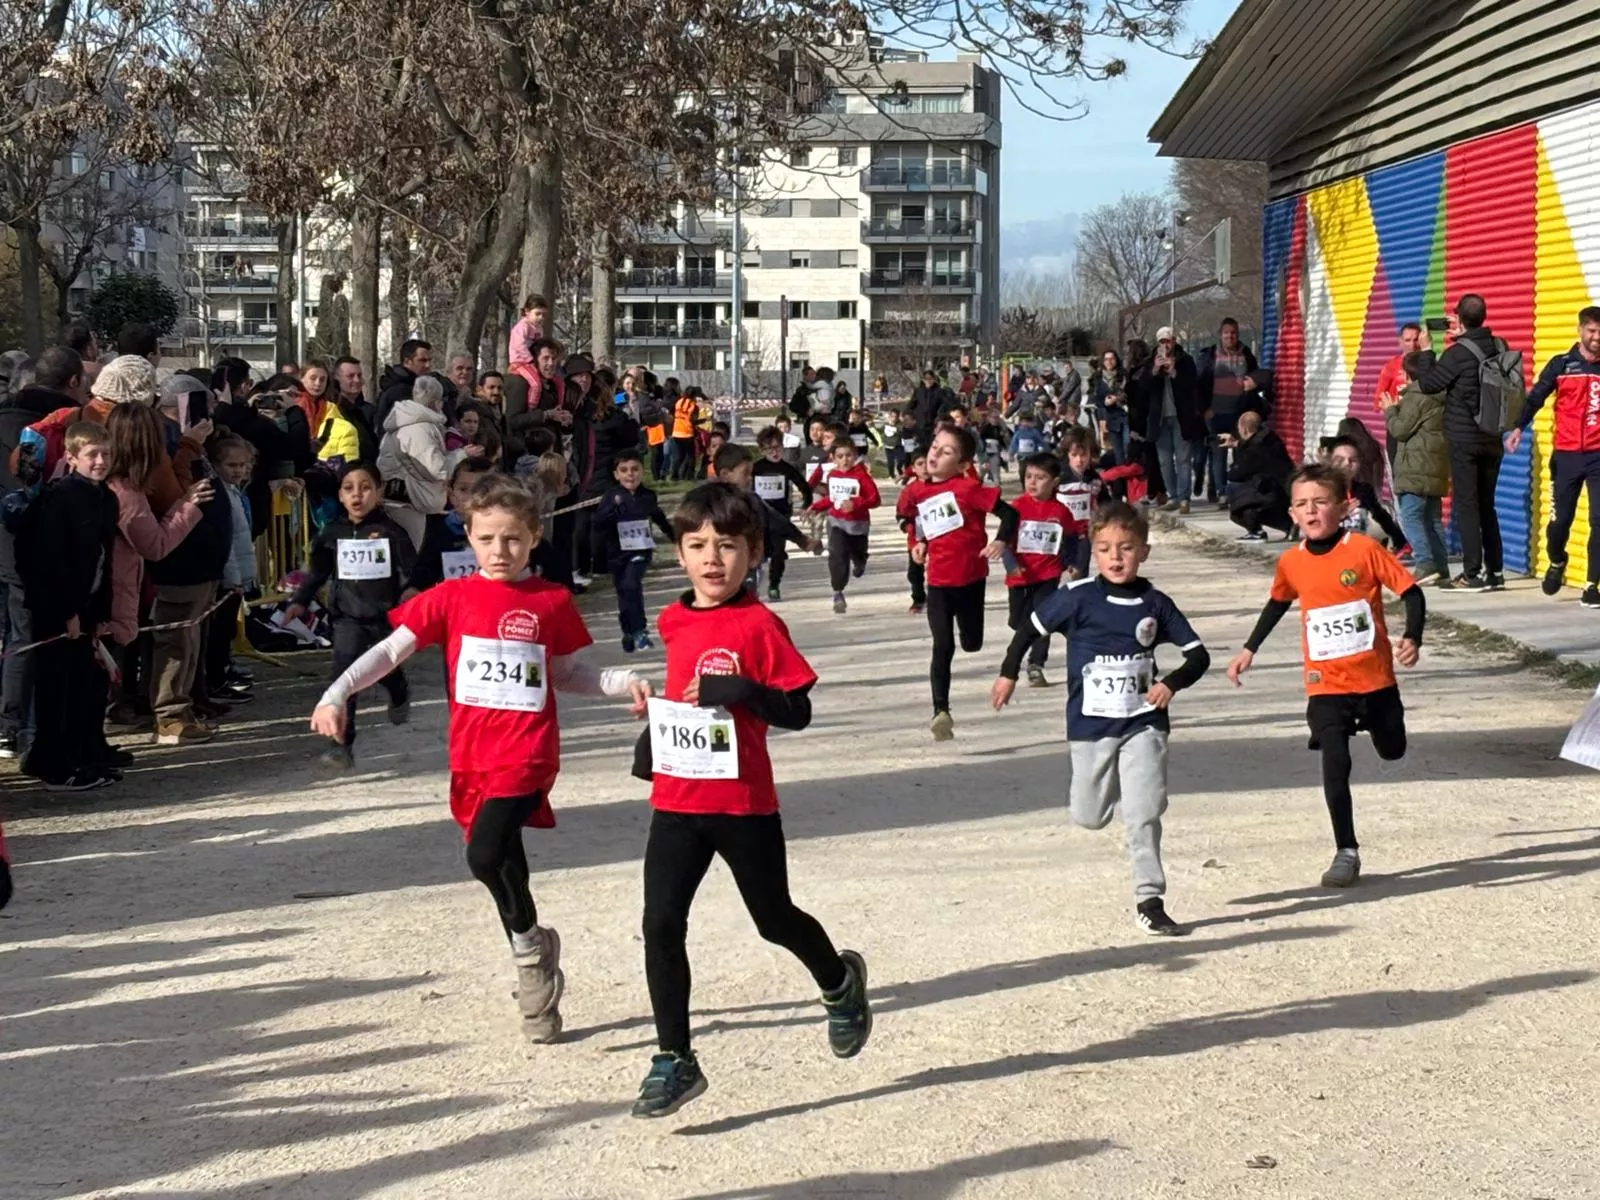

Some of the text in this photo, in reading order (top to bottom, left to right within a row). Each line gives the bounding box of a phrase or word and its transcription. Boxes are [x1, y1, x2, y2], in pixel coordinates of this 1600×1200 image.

[930, 506, 945, 522] 74
[1030, 530, 1050, 543] 347
[350, 550, 373, 563] 371
[1322, 617, 1355, 639] 355
[480, 660, 523, 684] 234
[1104, 676, 1137, 695] 373
[671, 724, 707, 750] 186
